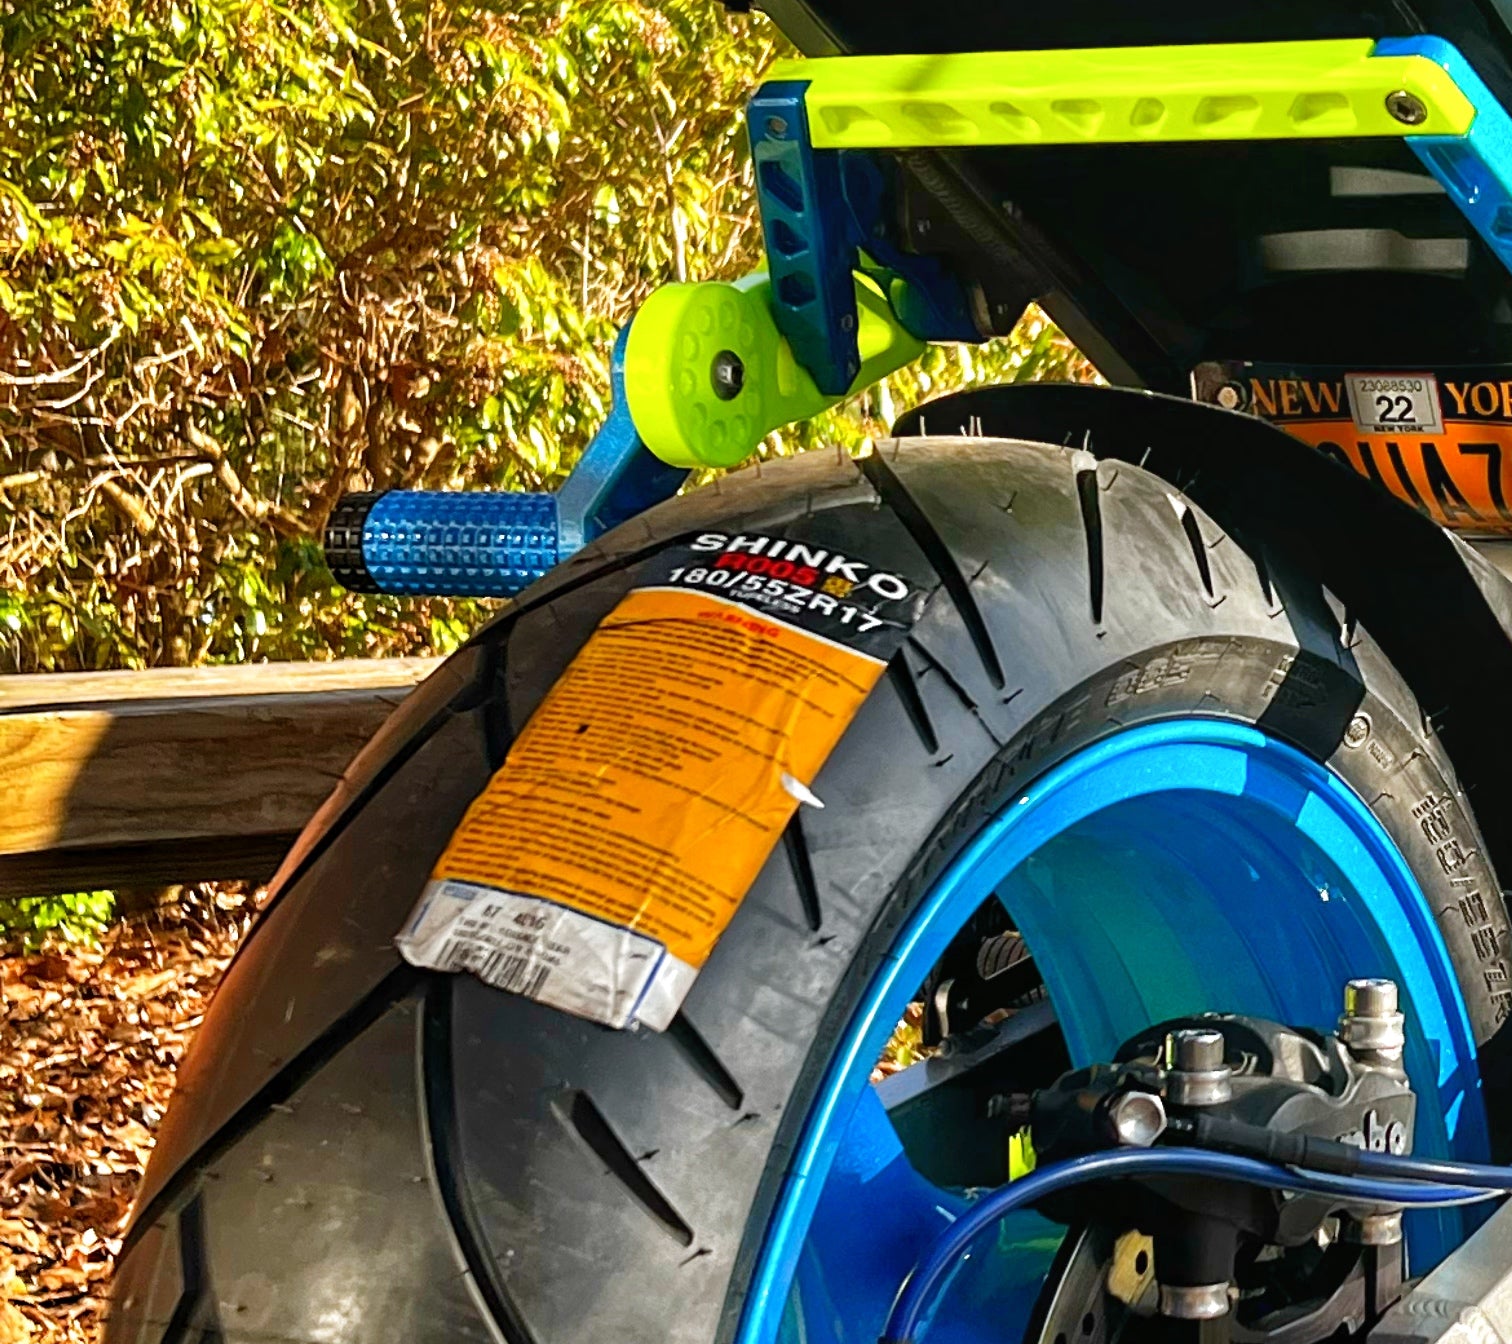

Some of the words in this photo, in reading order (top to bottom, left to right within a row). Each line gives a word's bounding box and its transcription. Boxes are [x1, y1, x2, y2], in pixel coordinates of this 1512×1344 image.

[1250, 378, 1343, 417] NEW
[1375, 395, 1416, 423] 22
[1374, 425, 1395, 433] NEW
[1398, 425, 1425, 433] YORK
[690, 533, 910, 601] SHINKO
[669, 567, 883, 633] 180/55ZR17
